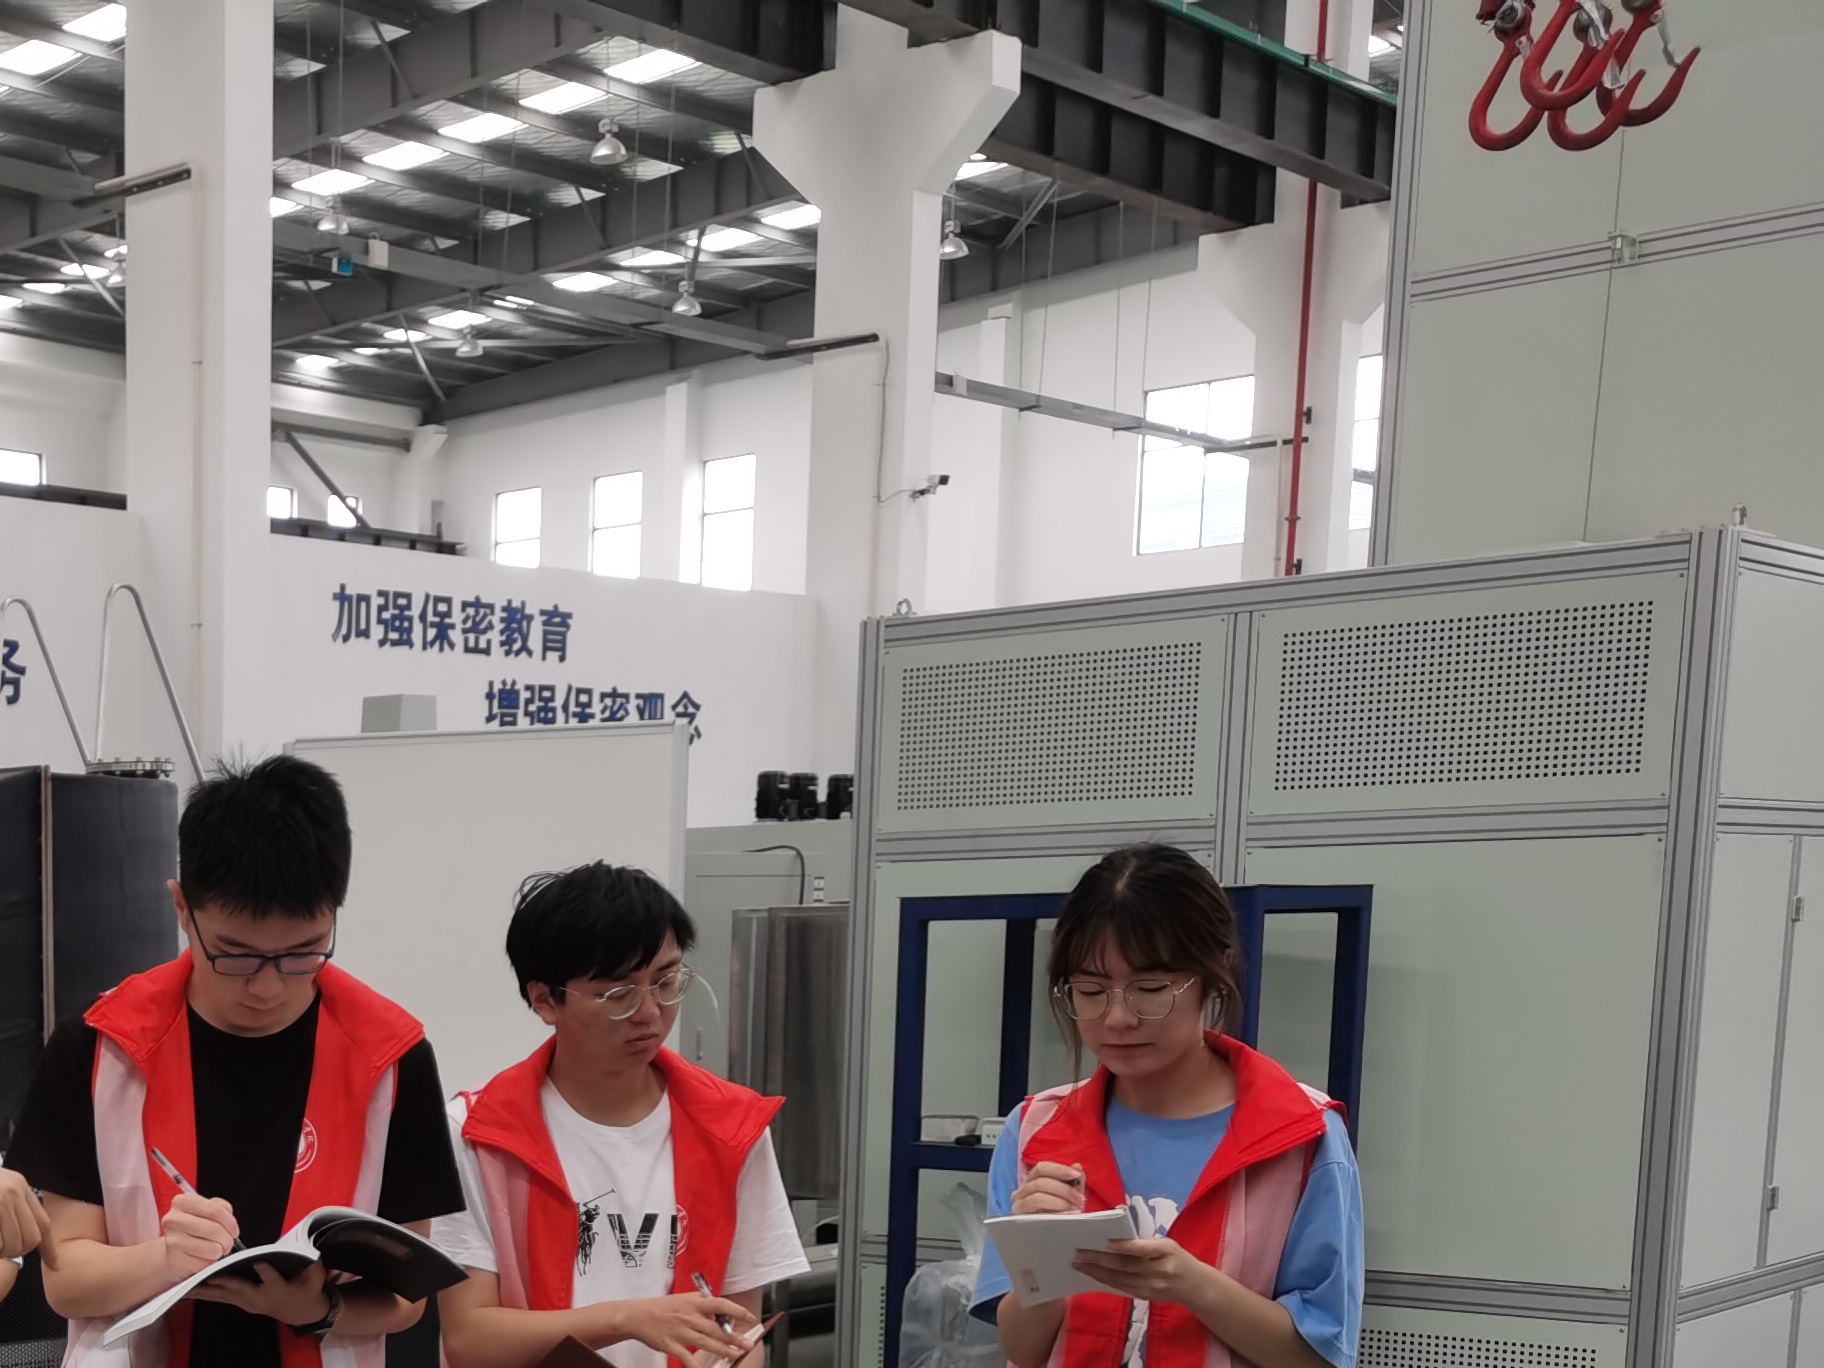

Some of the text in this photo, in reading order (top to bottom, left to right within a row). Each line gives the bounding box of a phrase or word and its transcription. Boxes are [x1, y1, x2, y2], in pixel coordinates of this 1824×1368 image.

[331, 583, 574, 663] 加强保密教育
